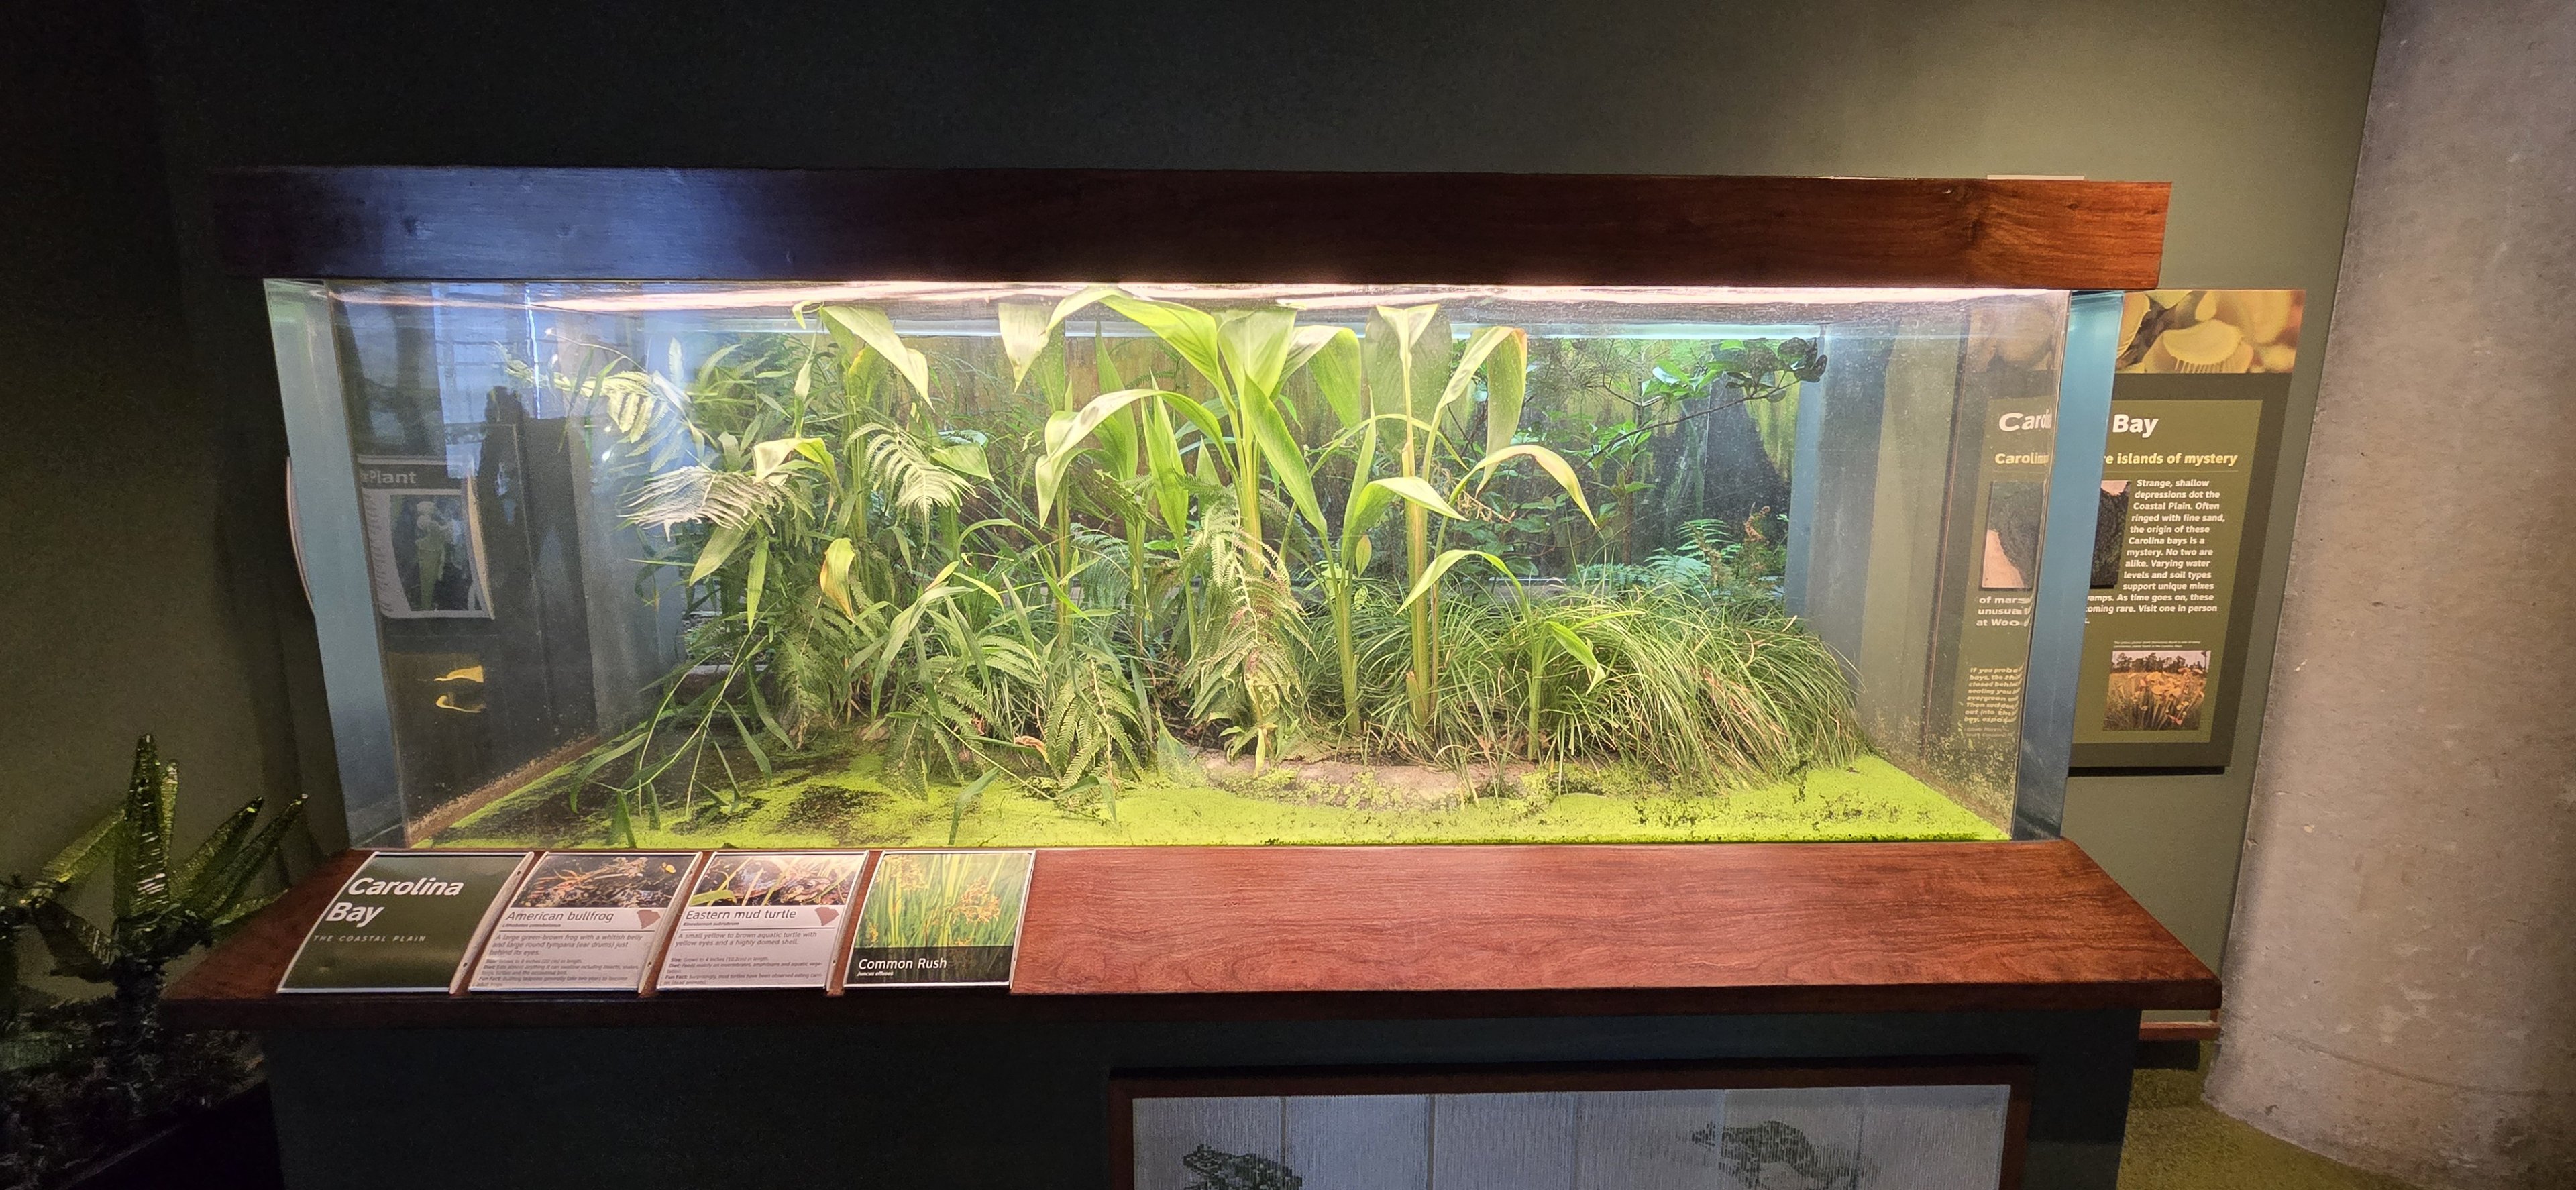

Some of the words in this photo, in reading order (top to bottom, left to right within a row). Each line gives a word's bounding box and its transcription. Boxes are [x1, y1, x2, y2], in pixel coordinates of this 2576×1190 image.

[2112, 414, 2159, 438] Bay
[2117, 453, 2163, 464] islands
[2167, 453, 2182, 464] of
[2184, 453, 2238, 466] mystery
[2137, 479, 2173, 488] Strange,
[2175, 479, 2210, 487] shallow
[2134, 490, 2186, 500] depressions
[2188, 490, 2204, 498] dot
[2206, 490, 2220, 498] the
[2133, 502, 2166, 510] Coastal
[2168, 502, 2193, 510] Plain.
[2195, 502, 2220, 510] Often
[2131, 514, 2159, 523] ringed
[2161, 514, 2181, 522] with
[2183, 514, 2200, 522] fine
[2202, 514, 2226, 523] sand,
[2130, 525, 2145, 533] the
[2146, 525, 2172, 535] origin
[2174, 525, 2184, 533] of
[2186, 525, 2210, 533] these
[2129, 537, 2165, 545] Carolina
[2167, 537, 2188, 546] bays
[2189, 537, 2197, 545] is
[2127, 549, 2163, 557] mystery.
[2165, 548, 2178, 556] No
[2125, 559, 2149, 567] alike.
[2151, 559, 2184, 570] Varying
[2188, 572, 2212, 581] types
[2123, 583, 2156, 591] support
[2158, 583, 2187, 592] unique
[1979, 596, 1992, 604] of
[2151, 595, 2173, 604] goes
[2174, 594, 2188, 603] on,
[2139, 604, 2157, 612] Visit
[2178, 604, 2186, 612] in
[2188, 605, 2218, 614] person
[348, 877, 464, 896] Carolina
[325, 902, 384, 928] Bay
[505, 911, 564, 921] American
[567, 911, 614, 923] bullfrog
[685, 910, 731, 920] Eastern
[734, 909, 762, 918] mud
[764, 908, 797, 918] turtle
[703, 932, 726, 940] yellow
[735, 939, 755, 947] highly
[858, 959, 913, 970] Common
[917, 957, 947, 969] Rush
